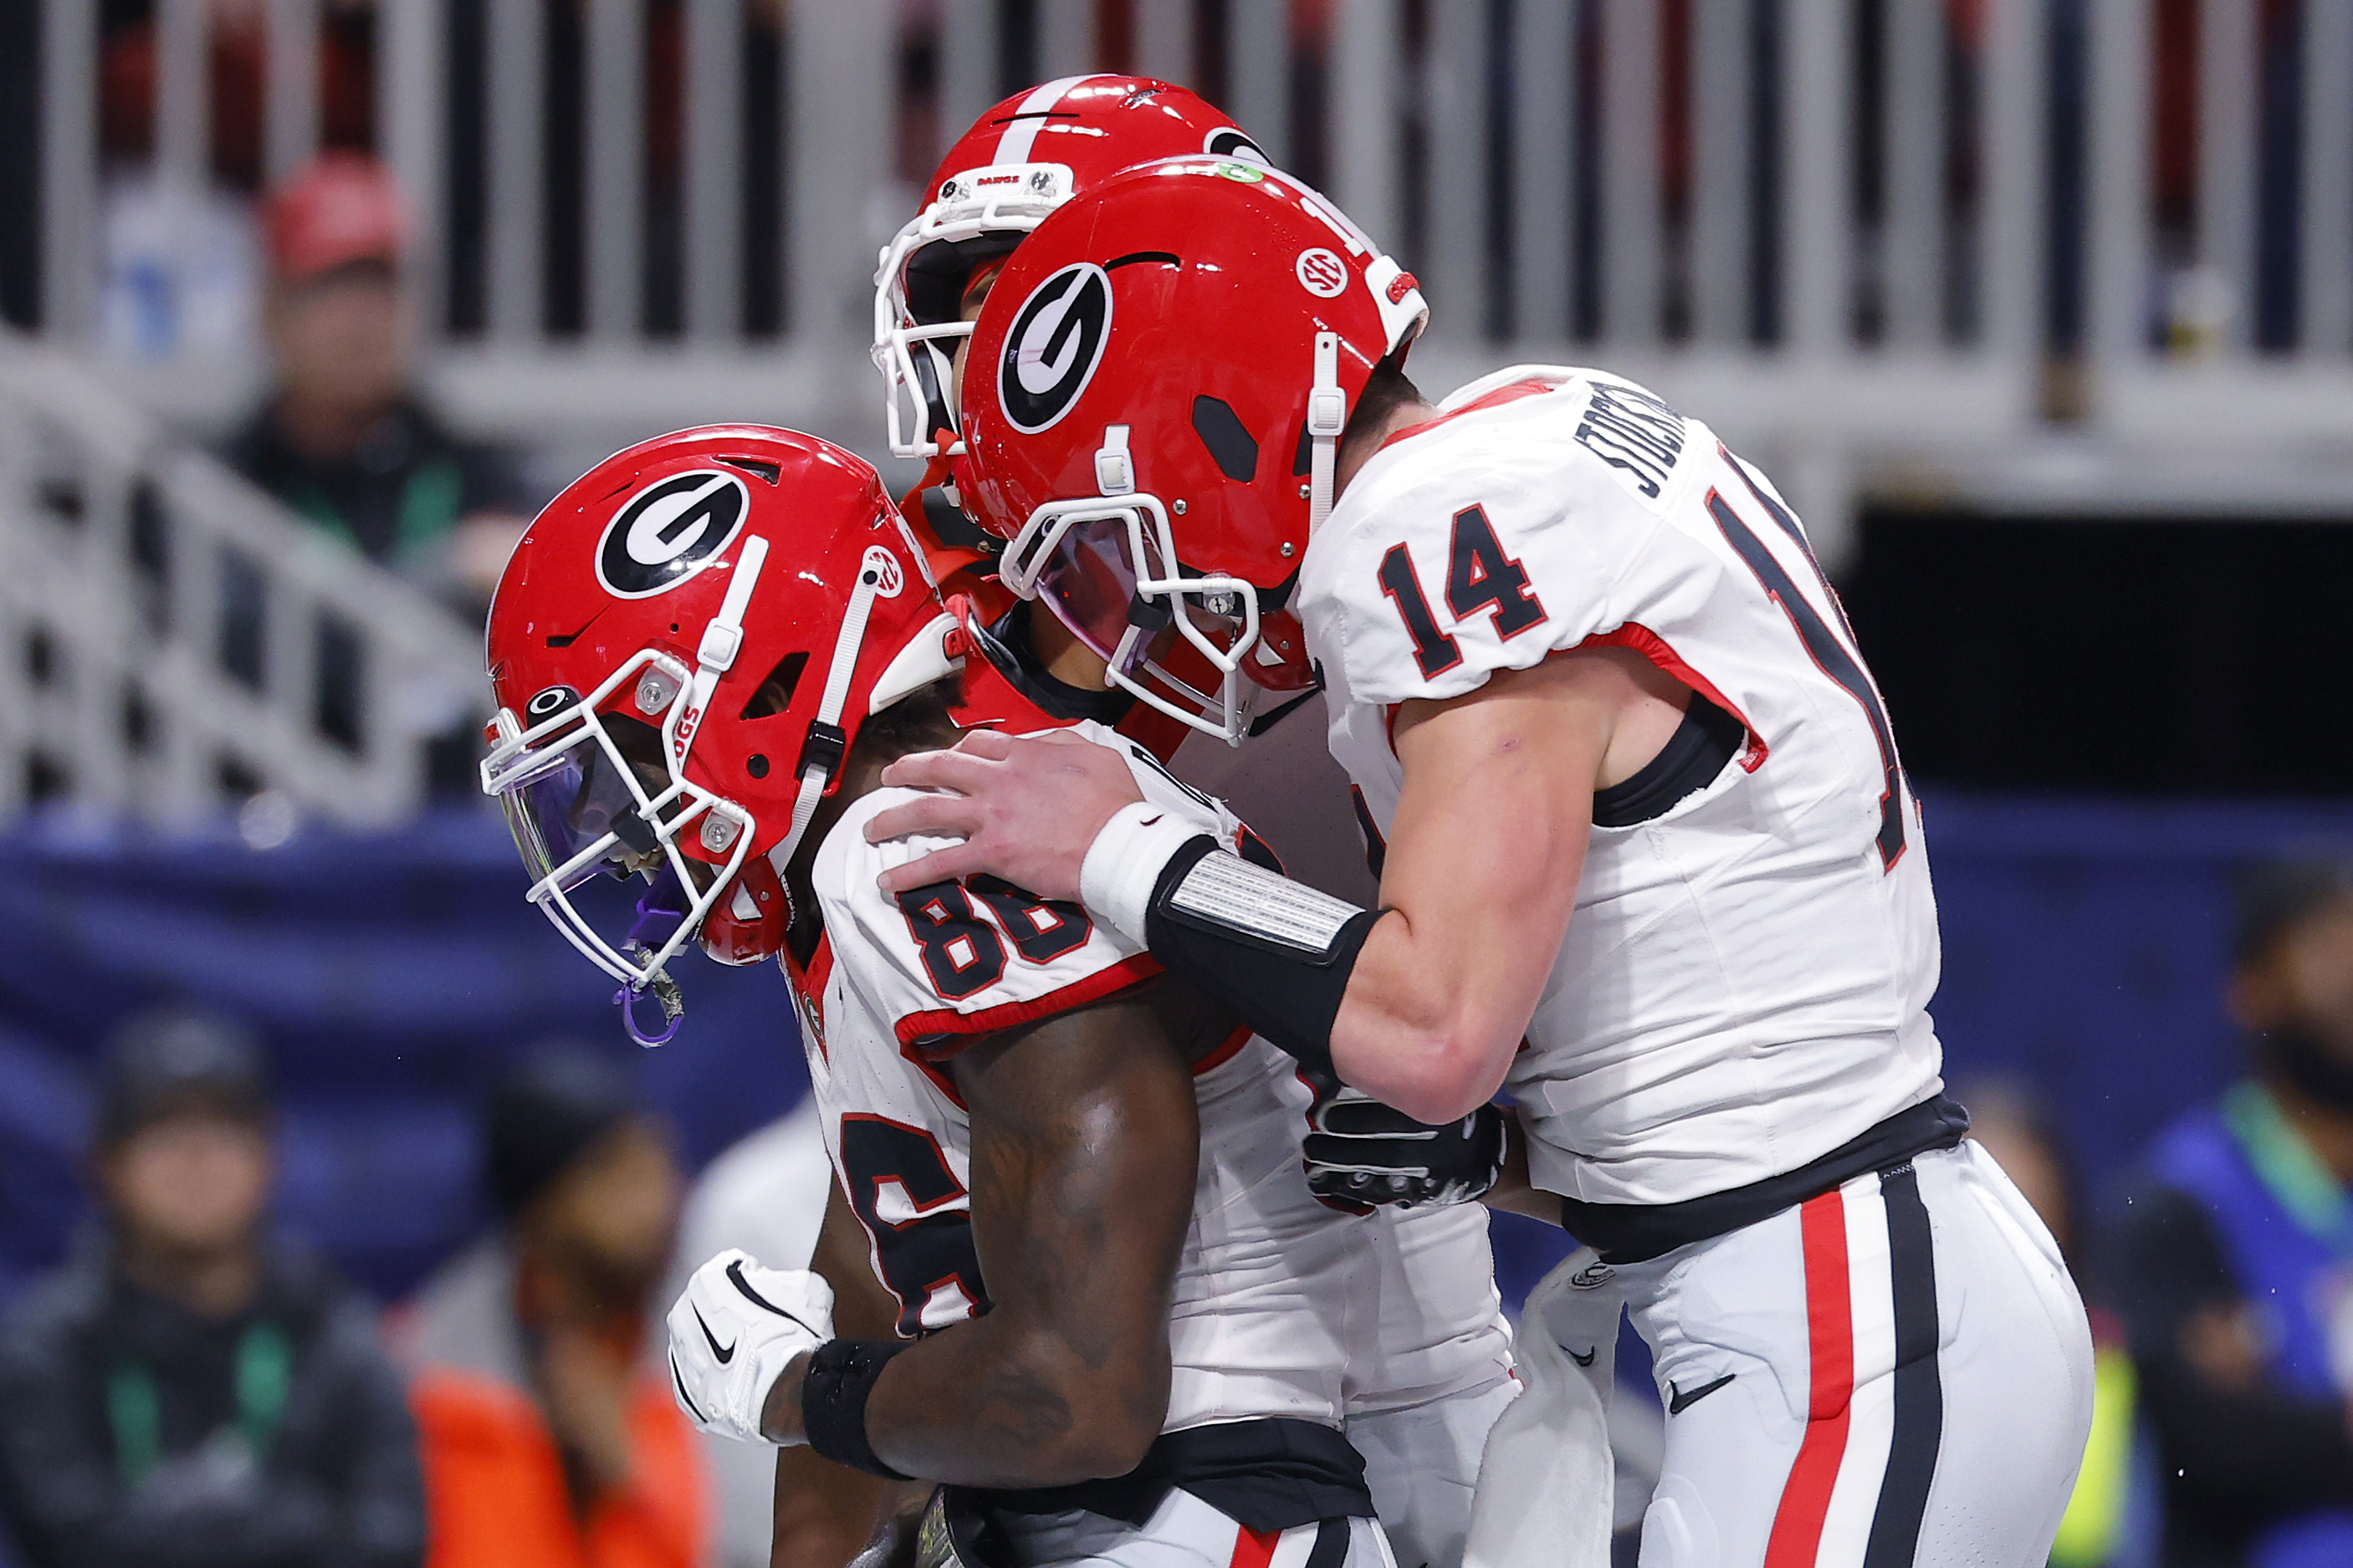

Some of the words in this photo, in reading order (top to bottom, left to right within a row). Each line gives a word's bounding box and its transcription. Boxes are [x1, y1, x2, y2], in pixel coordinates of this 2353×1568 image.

[1302, 253, 1343, 293] SEC
[1003, 268, 1107, 428] G
[601, 472, 744, 594] G
[1377, 502, 1549, 682] 14
